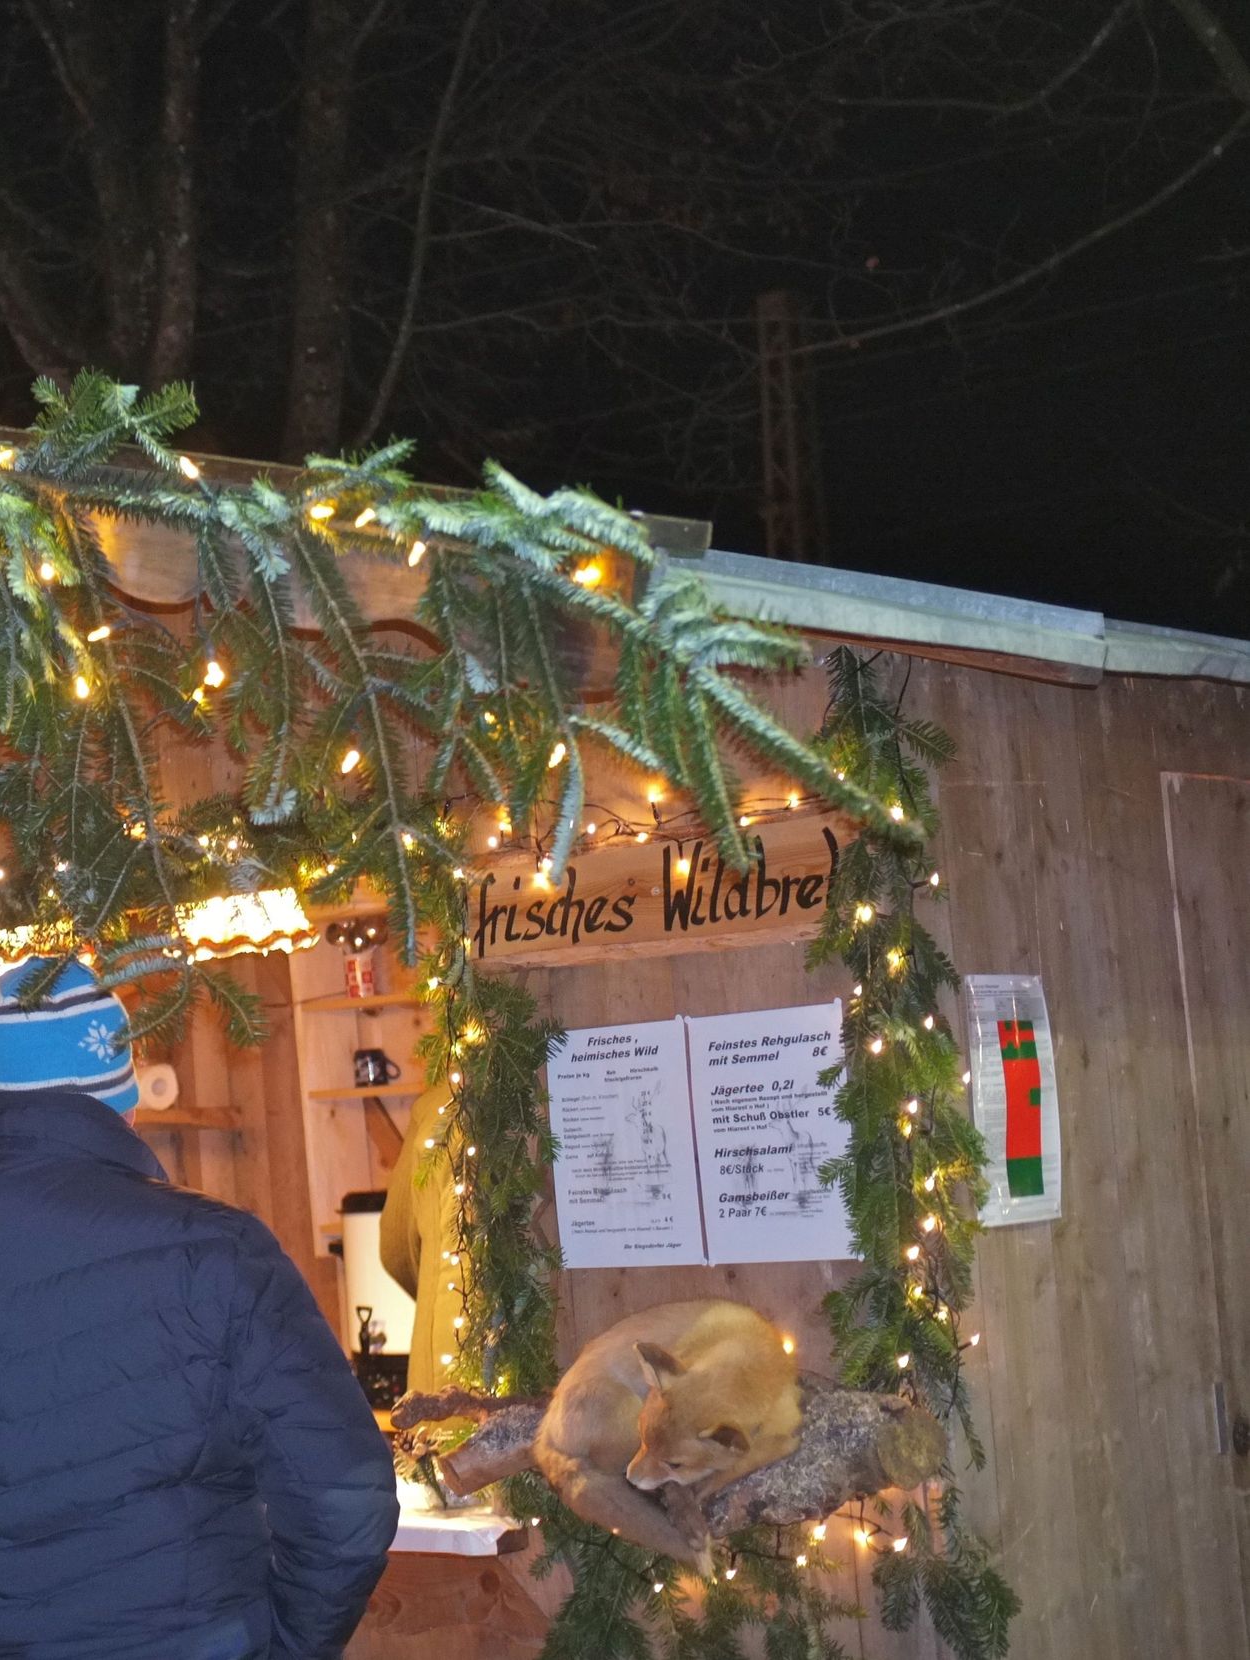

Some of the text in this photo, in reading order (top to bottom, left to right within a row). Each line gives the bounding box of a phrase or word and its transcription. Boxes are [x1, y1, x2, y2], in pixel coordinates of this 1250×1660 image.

[474, 865, 636, 958] frisches
[587, 1035, 631, 1047] Frisches
[708, 1031, 831, 1052] Feinstes Rehgulasch
[570, 1046, 659, 1063] heimisches Wild
[708, 1046, 828, 1066] mit Semmel 8€
[710, 1084, 764, 1097] Jägertee
[712, 1107, 831, 1124] mit Schuß Obstler 5€
[714, 1143, 793, 1159] Hirschsalami
[719, 1190, 790, 1203] Gamsbeißer
[719, 1208, 725, 1218] 2
[728, 1207, 752, 1218] Paar
[755, 1206, 767, 1217] 7€
